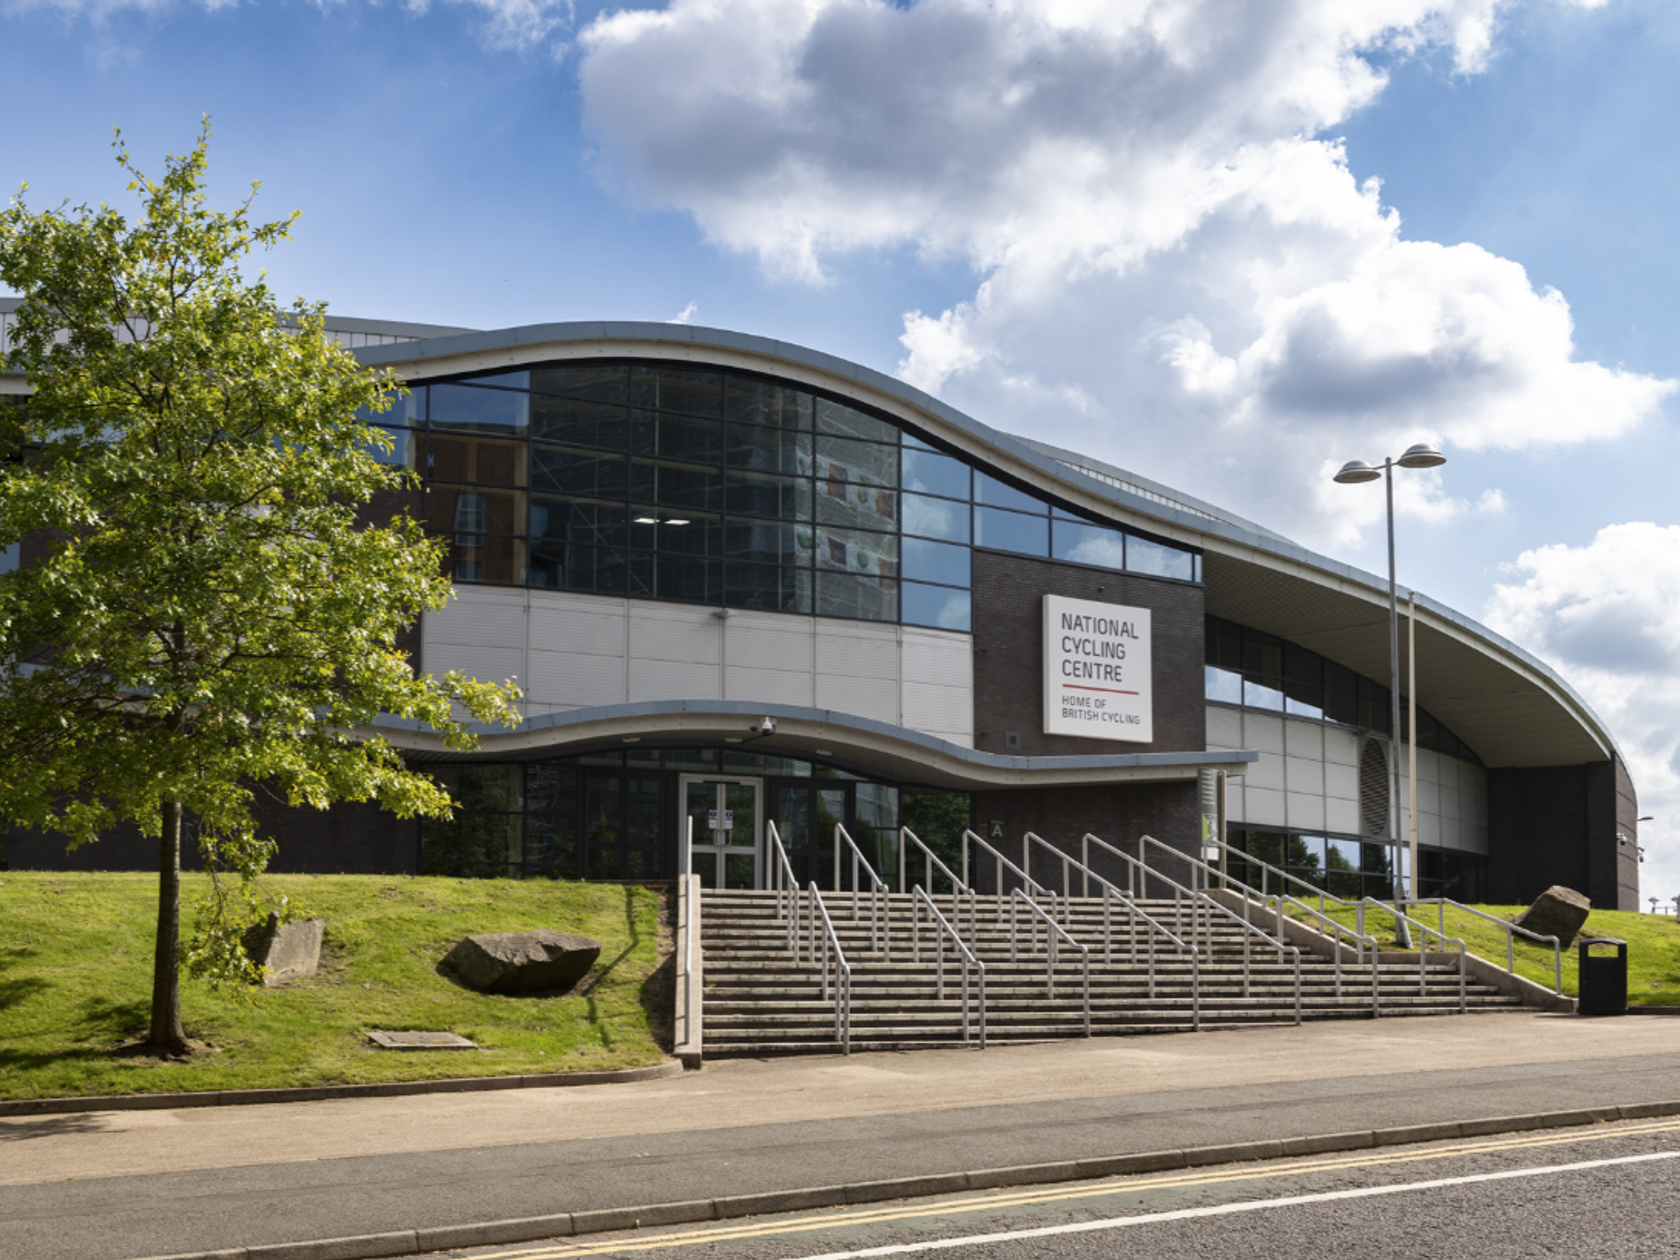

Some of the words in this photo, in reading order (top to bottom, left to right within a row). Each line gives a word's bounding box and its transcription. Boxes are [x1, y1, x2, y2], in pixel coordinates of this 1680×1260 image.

[1062, 612, 1139, 639] NATIONAL
[1062, 636, 1126, 660] CYCLING
[1062, 659, 1122, 682] CENTRE
[1062, 695, 1091, 708] HOME
[1094, 698, 1106, 709] OF
[1062, 707, 1099, 721] BRITISH
[1101, 711, 1140, 725] CYCLING
[991, 824, 1003, 837] A
